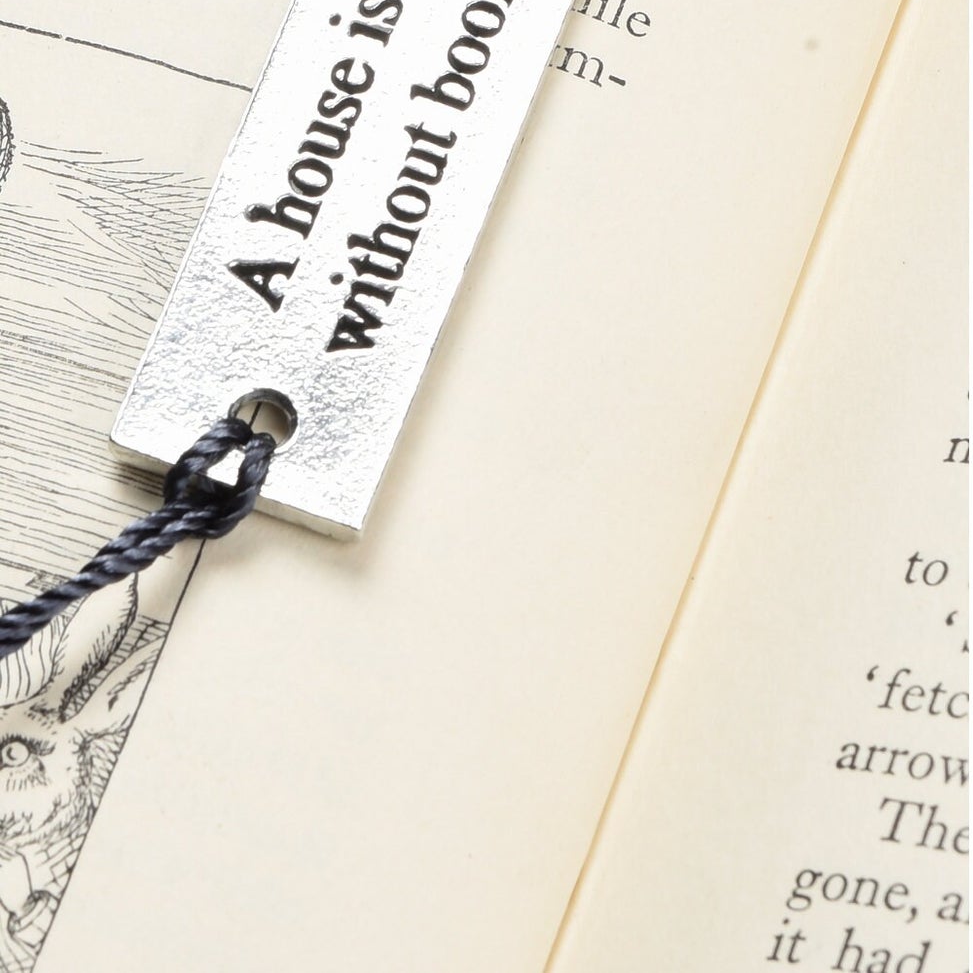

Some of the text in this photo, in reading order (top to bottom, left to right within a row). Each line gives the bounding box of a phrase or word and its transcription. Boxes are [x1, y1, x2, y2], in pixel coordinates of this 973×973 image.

[244, 57, 376, 240] house
[324, 121, 458, 354] without
[227, 256, 300, 314] A
[904, 551, 949, 587] to
[786, 868, 919, 924] gone,
[766, 917, 932, 973] it had
